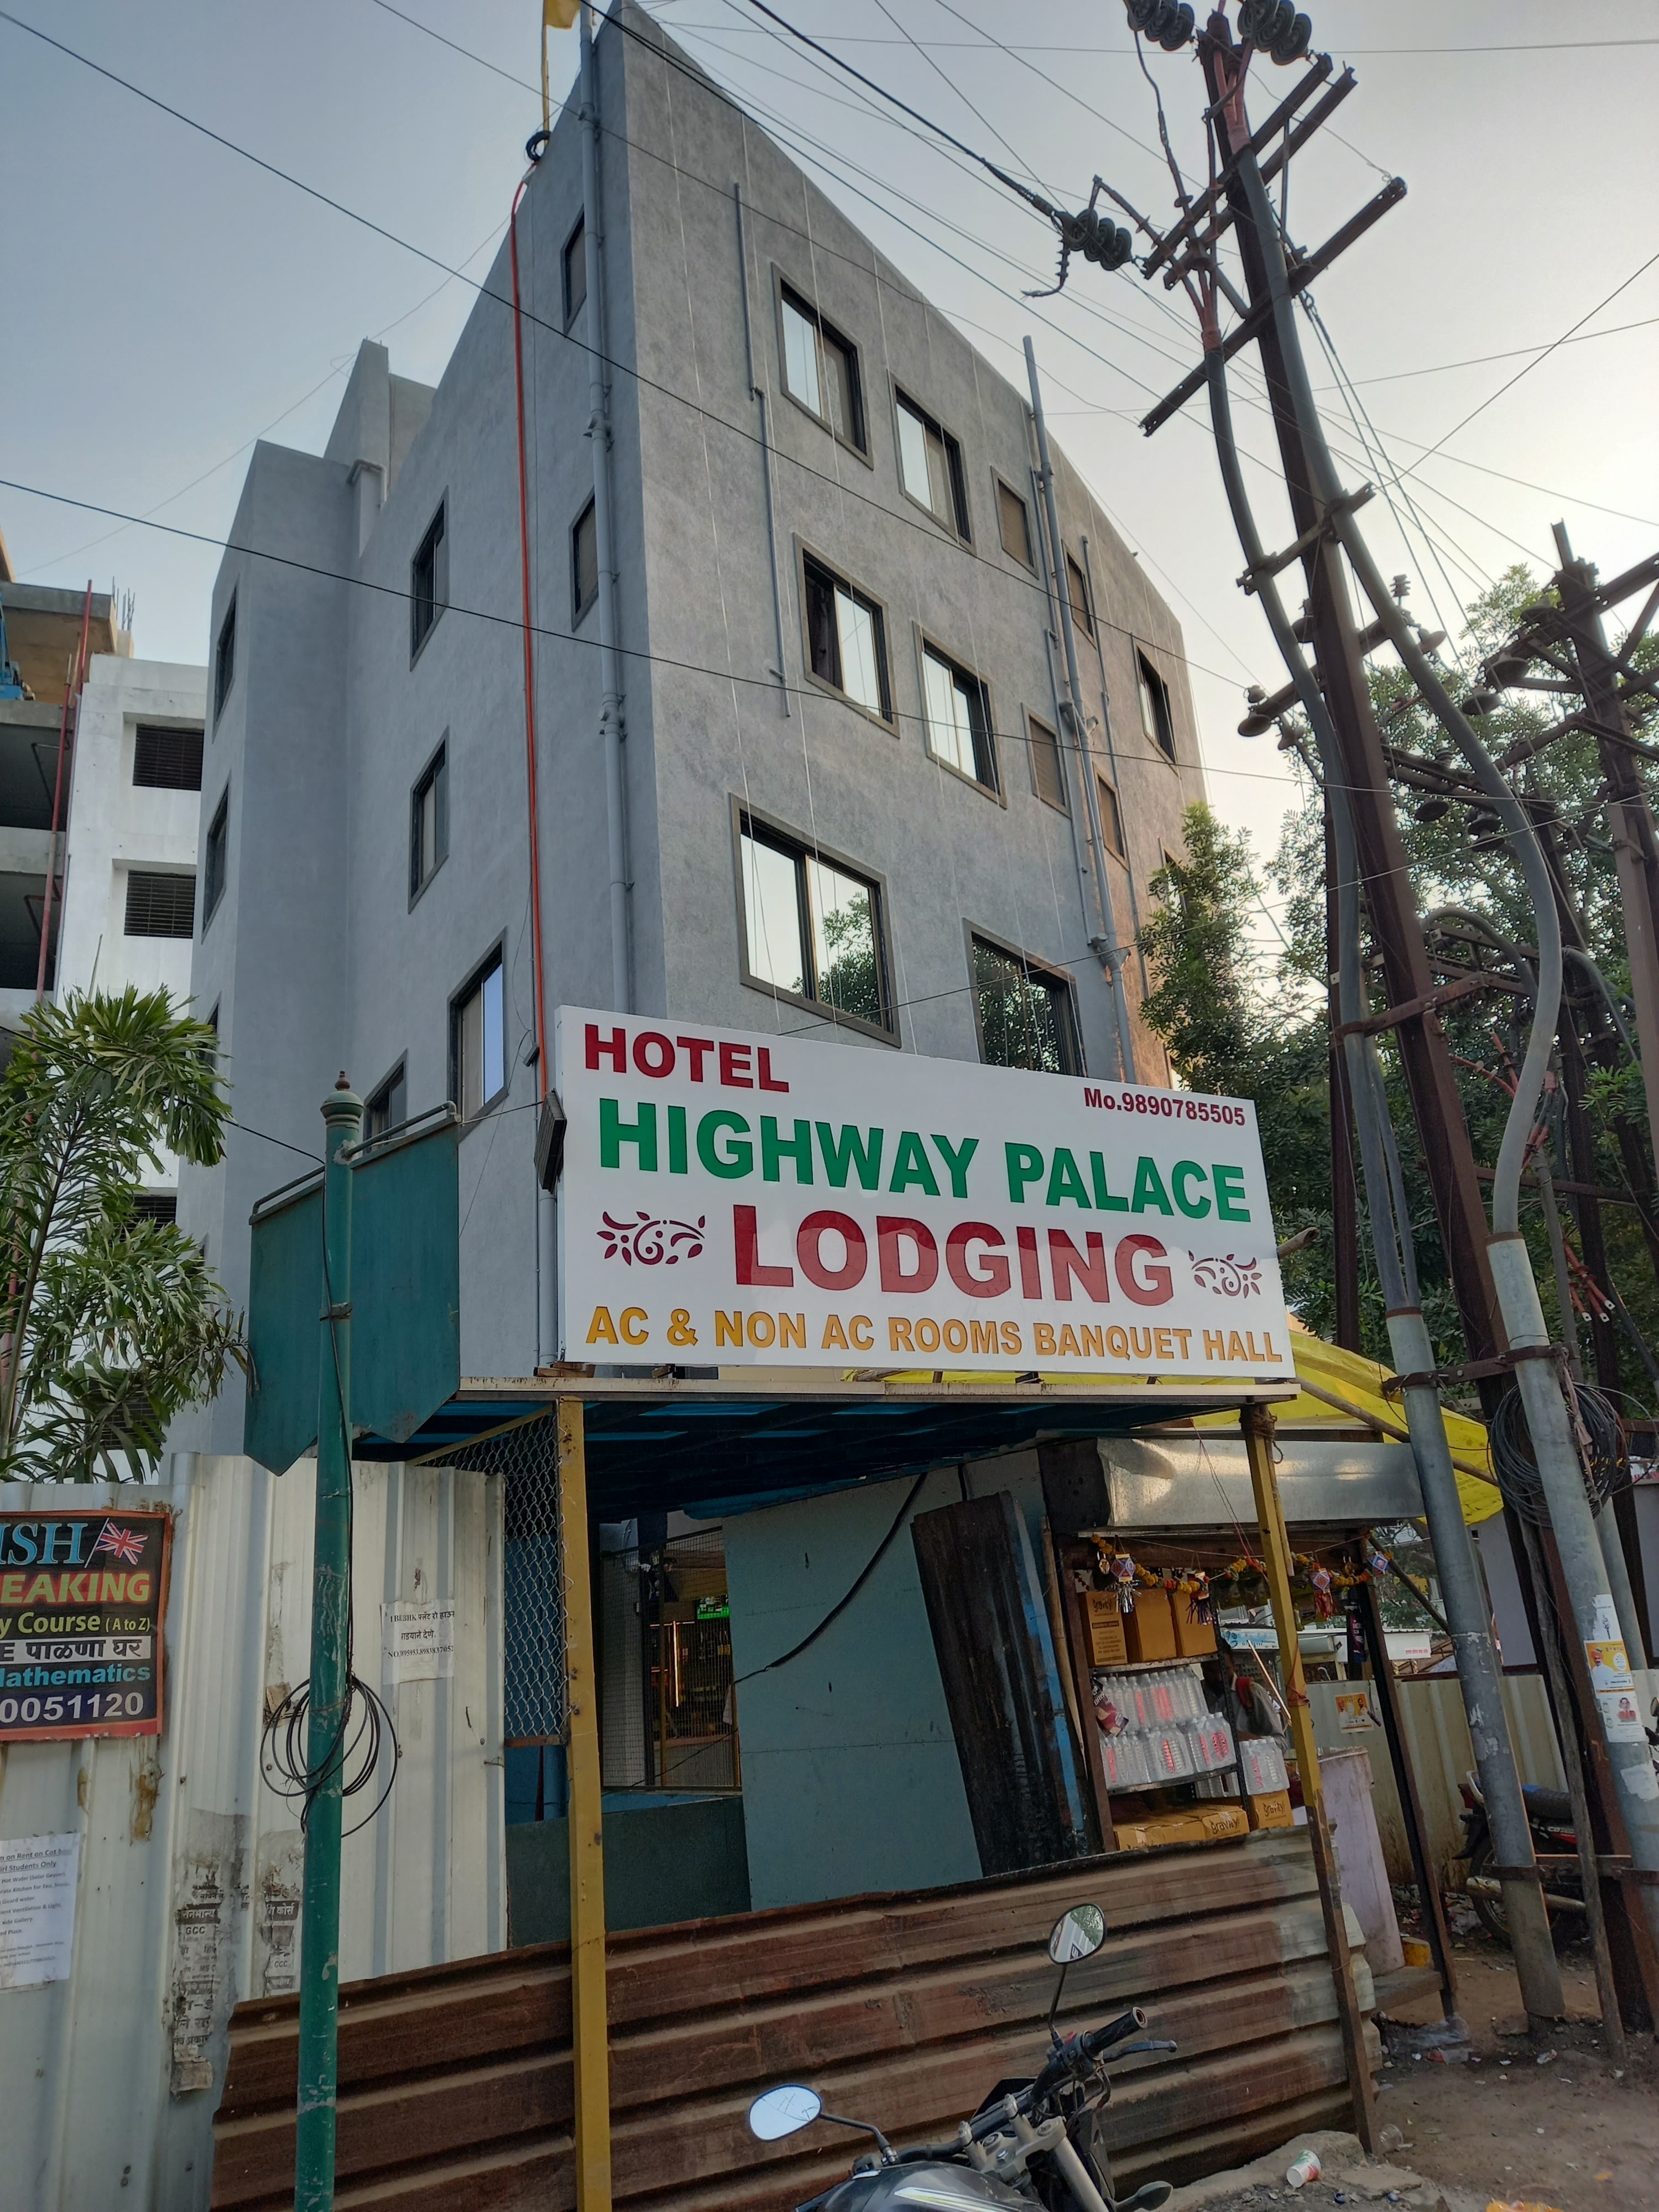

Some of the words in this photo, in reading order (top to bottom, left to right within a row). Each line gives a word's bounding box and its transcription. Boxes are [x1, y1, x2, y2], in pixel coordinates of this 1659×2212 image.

[585, 1023, 789, 1093] HOTEL
[1084, 1087, 1245, 1125] Mo.9890785505
[599, 1097, 979, 1199] HIGHWAY
[1004, 1141, 1251, 1222] PALACE
[733, 1204, 1174, 1306] LODGING
[586, 1306, 649, 1345] AC
[667, 1308, 698, 1347] &
[714, 1310, 806, 1349] NON
[821, 1314, 874, 1351] AC
[888, 1317, 1022, 1355] ROOMS
[1032, 1322, 1192, 1361] BANQUET
[1202, 1329, 1282, 1363] HALL
[18, 1611, 101, 1634] Course
[124, 1616, 136, 1630] to
[25, 1639, 106, 1660] पाळणा
[112, 1639, 142, 1657] घर
[1263, 1799, 1284, 1817] gravity
[1209, 1818, 1239, 1834] gravity
[8, 1863, 39, 1871] Students
[40, 1860, 57, 1869] Only
[186, 1926, 205, 1935] GCC
